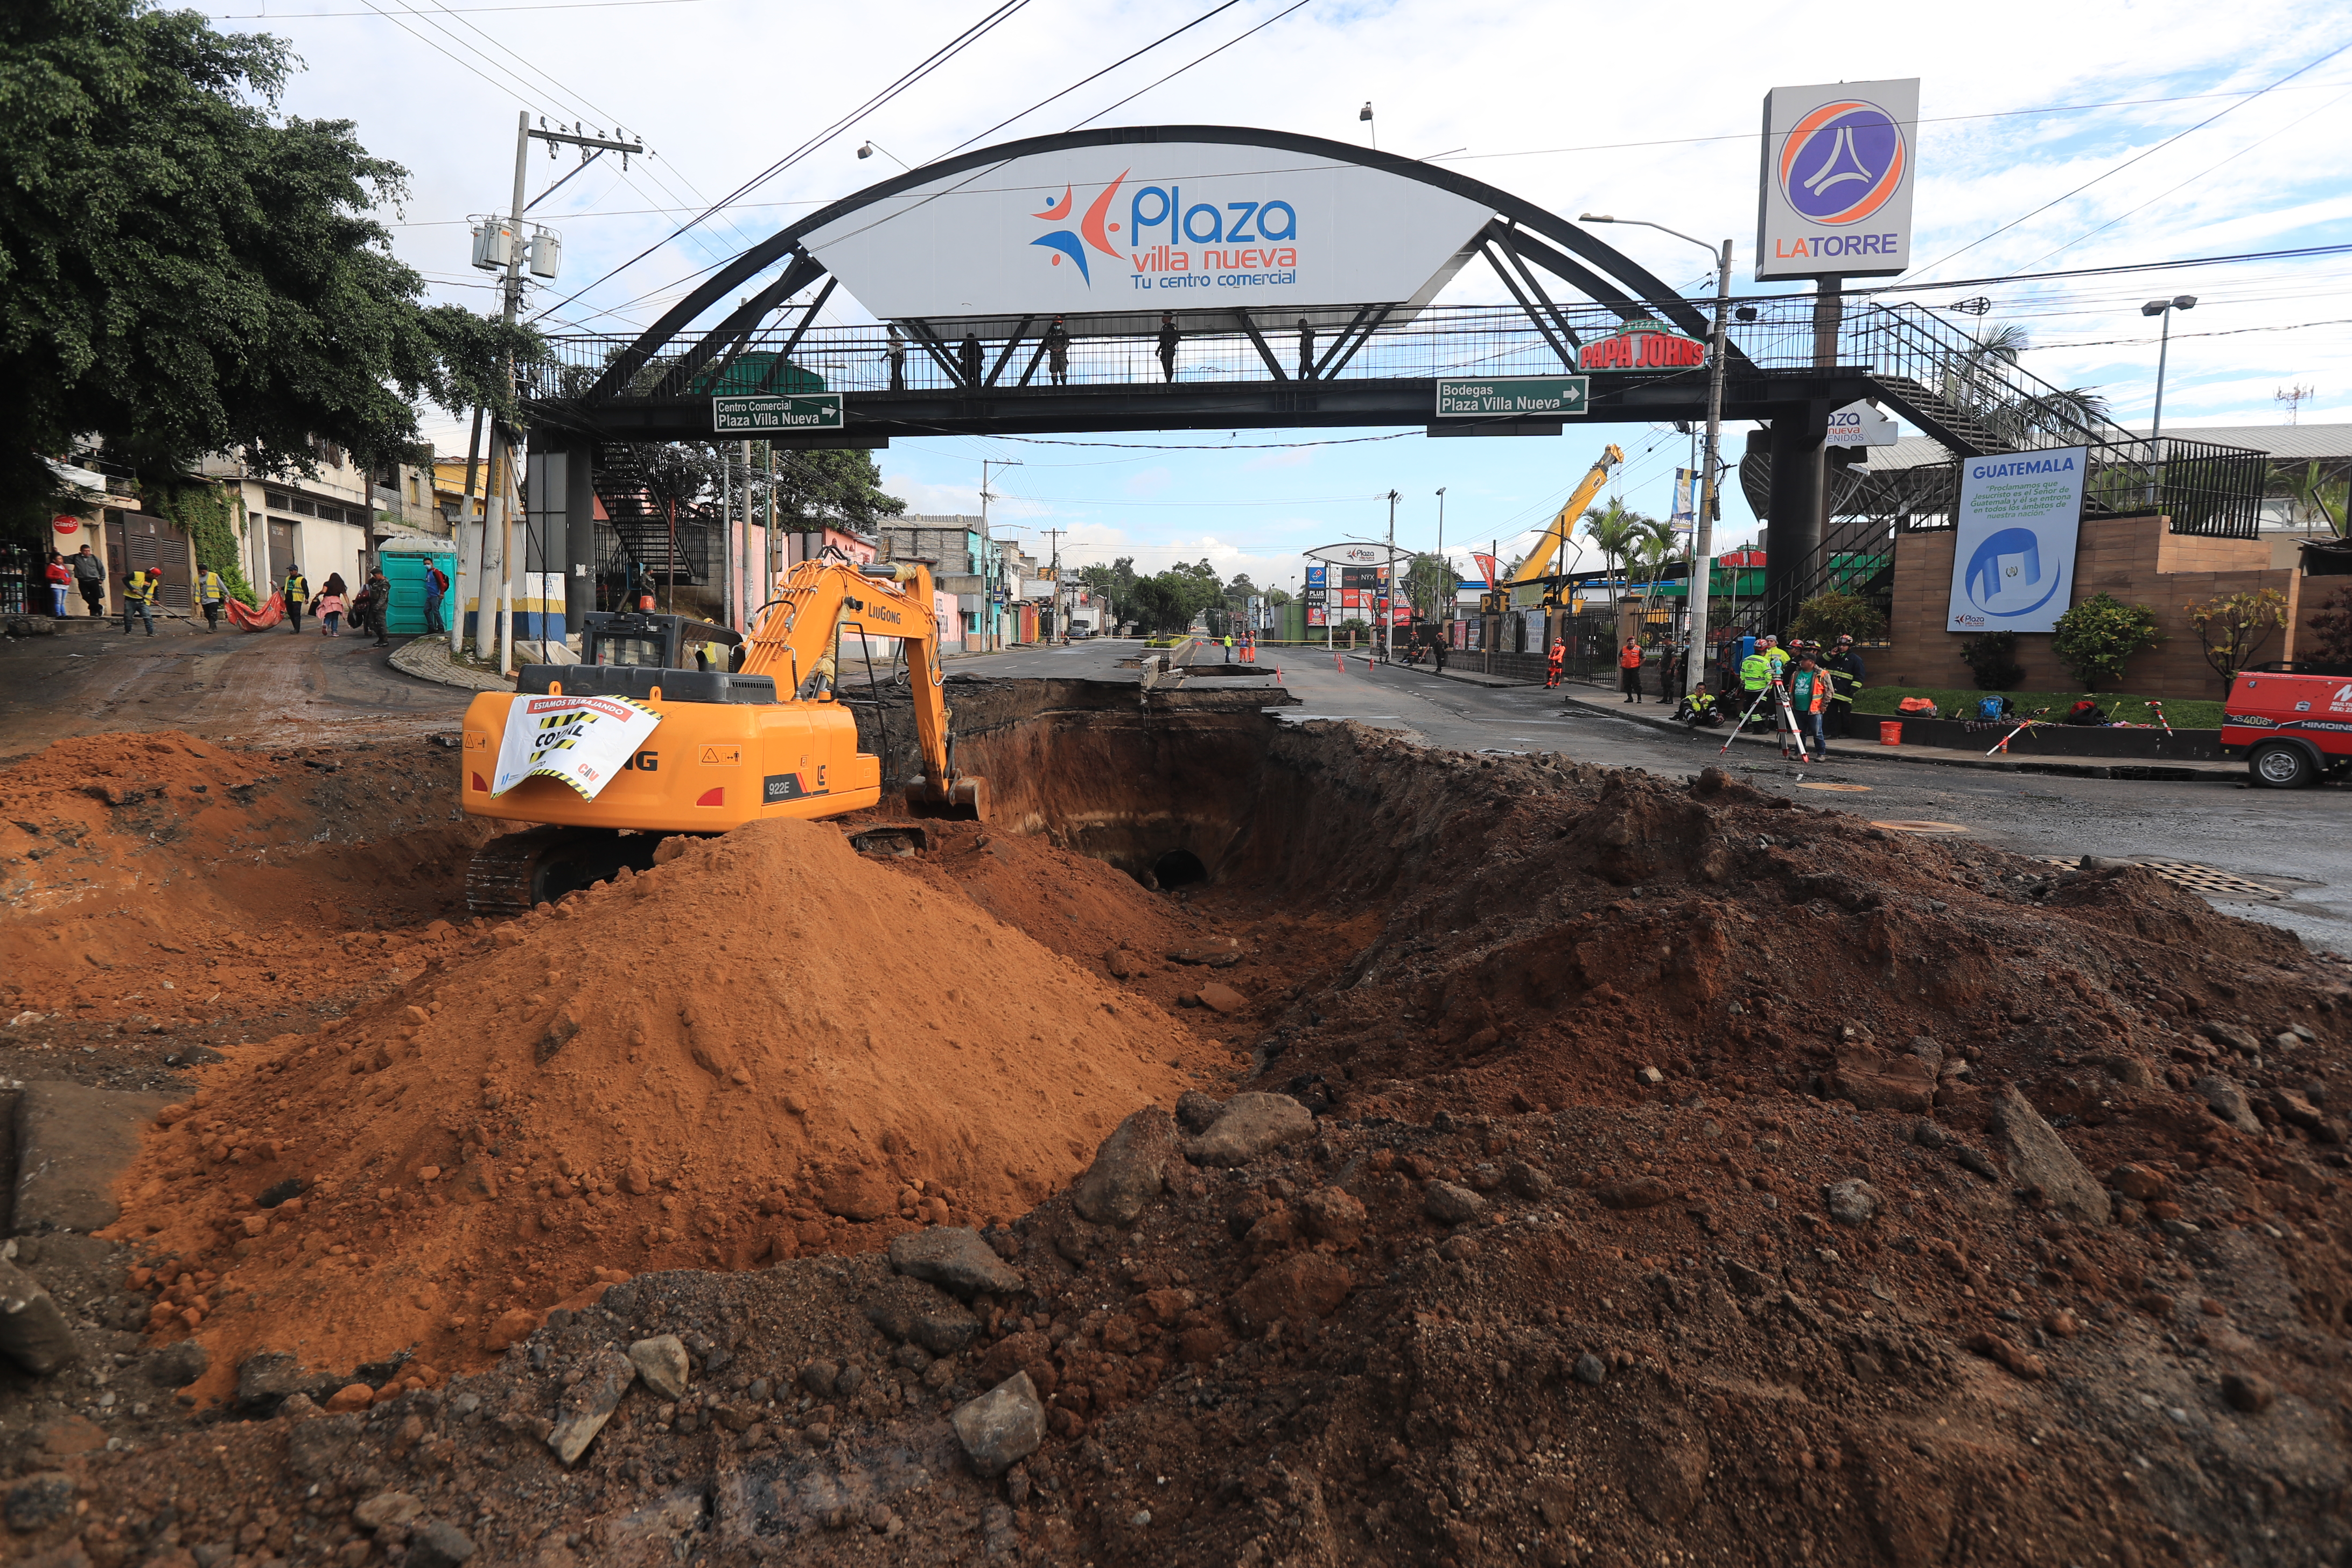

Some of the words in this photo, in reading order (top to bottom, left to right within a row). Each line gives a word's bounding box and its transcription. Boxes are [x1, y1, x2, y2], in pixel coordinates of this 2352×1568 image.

[1131, 185, 1296, 246] Plaza
[1132, 245, 1188, 272] villa
[1204, 247, 1297, 270] nueva
[1131, 275, 1151, 290] Tu
[1159, 274, 1210, 289] centro
[1217, 269, 1296, 287] comercial
[1627, 321, 1658, 330] PIZZA
[1581, 336, 1633, 369] PAPA
[1443, 385, 1493, 397] Bodegas
[718, 402, 746, 412] Centro
[749, 400, 792, 411] Comercial
[1442, 398, 1479, 411] Plaza
[1483, 397, 1513, 410] Villa
[1517, 396, 1560, 410] Nueva
[719, 415, 750, 426] Plaza
[753, 412, 779, 425] Villa
[782, 412, 819, 425] Nueva
[1828, 434, 1864, 442] ENIDOS
[1973, 457, 2074, 479] GUATEMALA
[2042, 481, 2058, 489] que
[1970, 498, 2011, 507] Guatemala
[2020, 495, 2027, 503] él
[1973, 491, 2011, 500] Jesucristo
[2022, 502, 2054, 510] ámbitos
[1720, 552, 1745, 566] PAPA
[534, 699, 566, 710] ESTAMOS
[567, 698, 624, 715] TRABAJANDO
[578, 763, 599, 782] CAV
[769, 781, 789, 795] 922E
